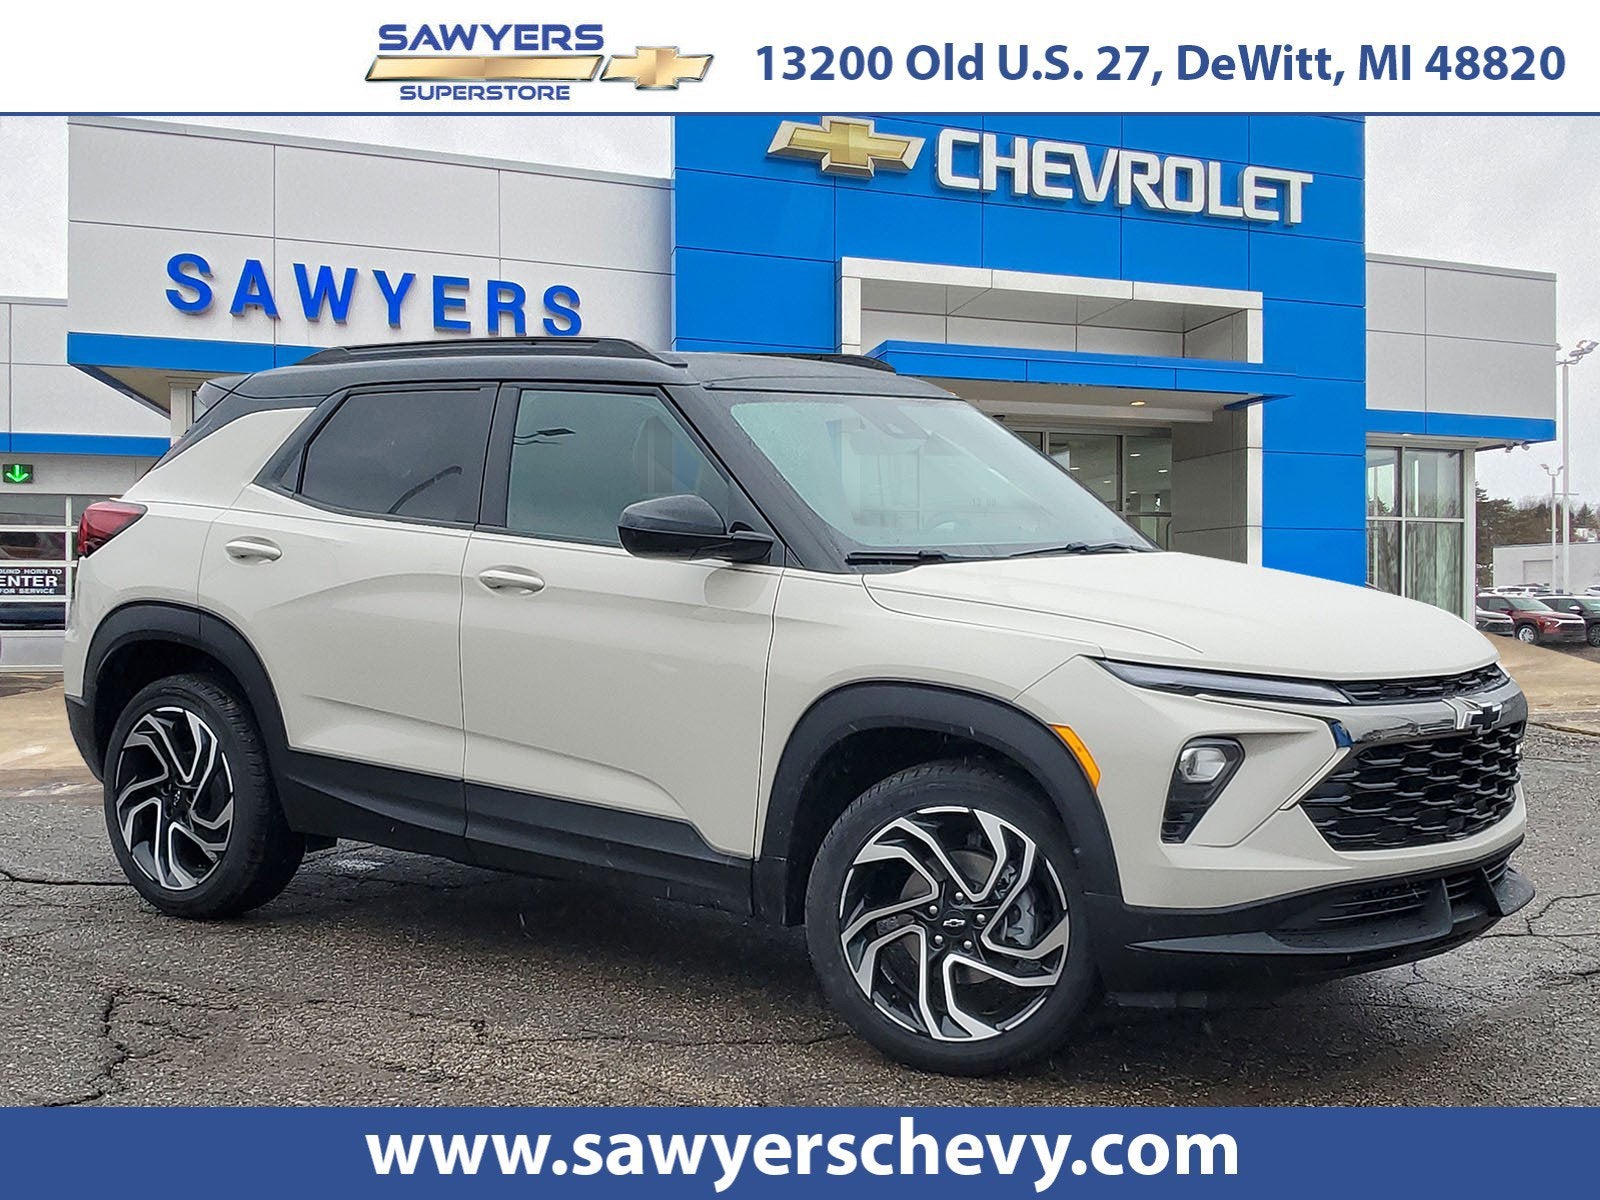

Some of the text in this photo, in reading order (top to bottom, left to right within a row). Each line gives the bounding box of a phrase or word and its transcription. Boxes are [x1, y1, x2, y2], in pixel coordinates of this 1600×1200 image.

[936, 127, 1314, 225] CHEVROLET
[165, 253, 583, 337] SAWYERS
[0, 575, 58, 587] ENTER
